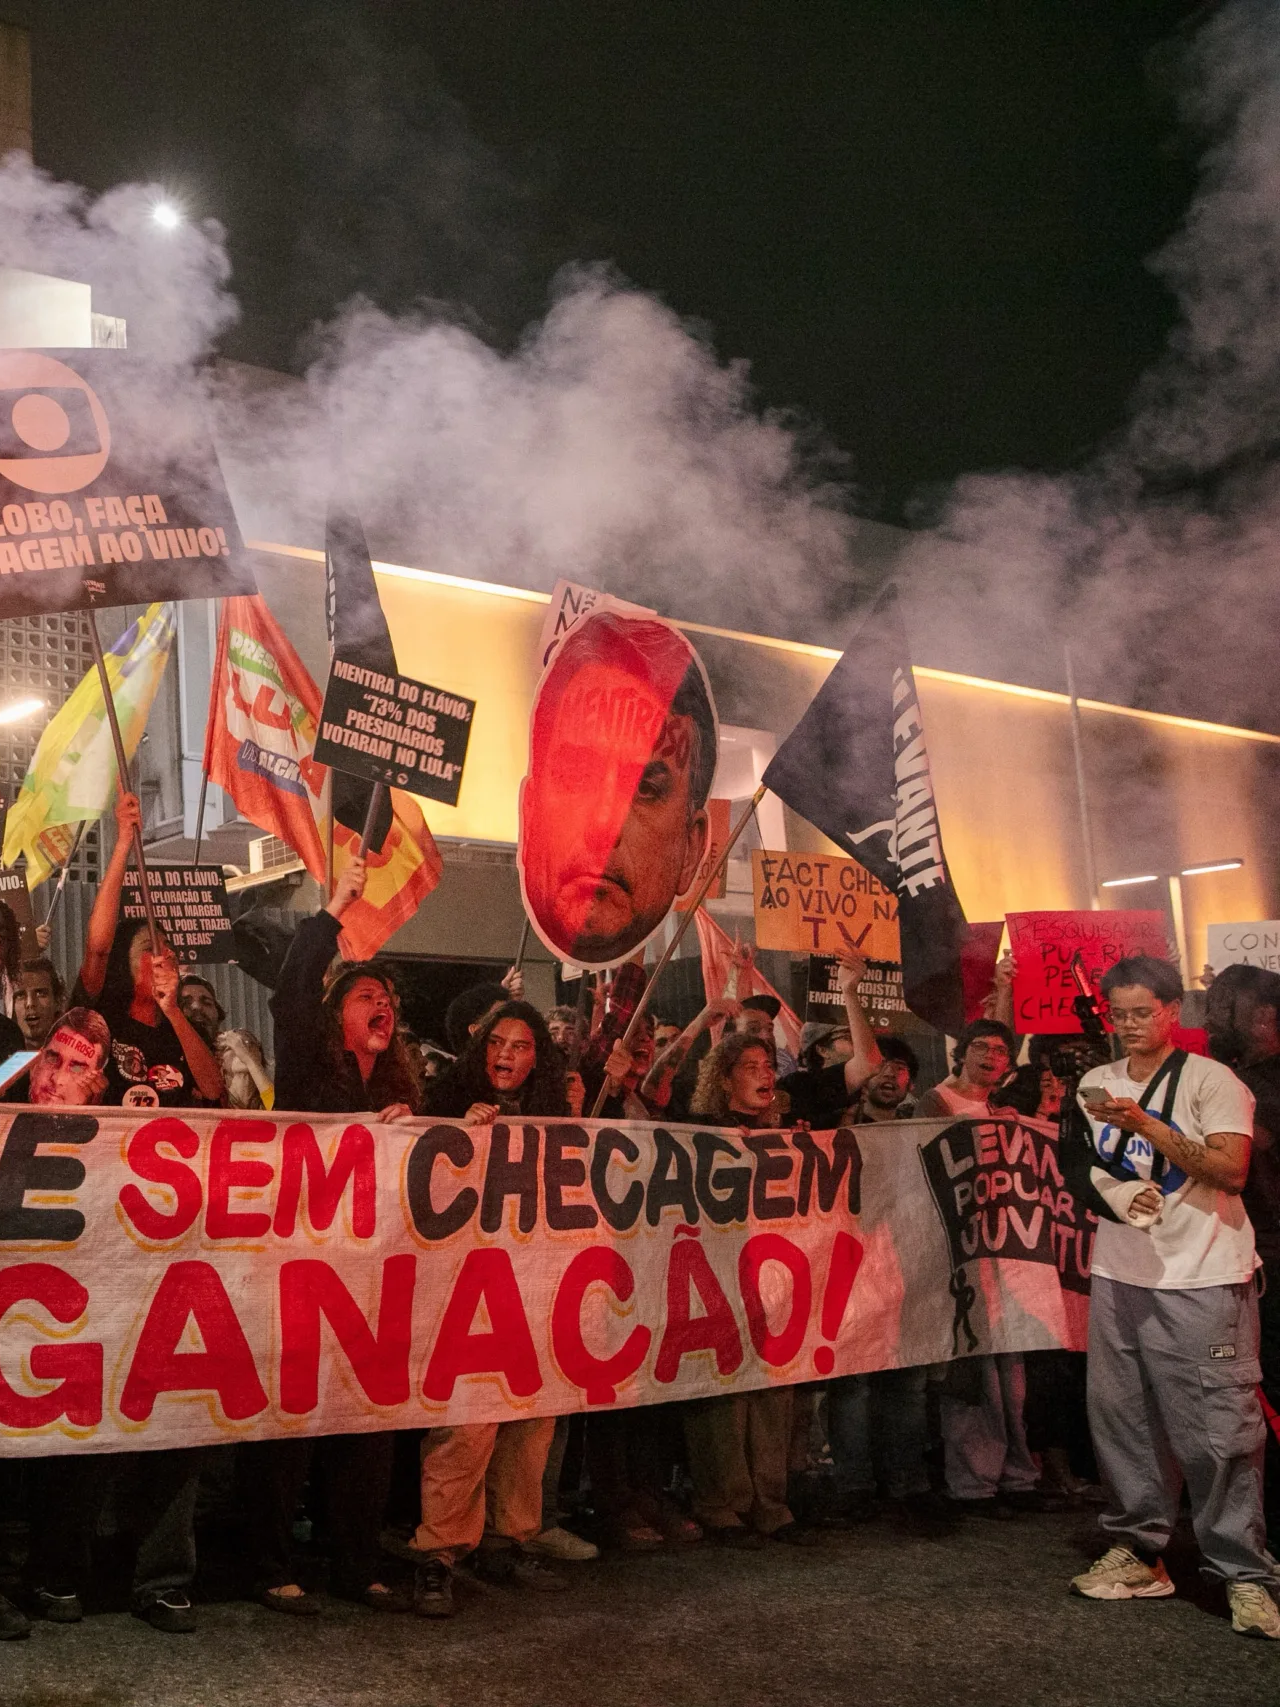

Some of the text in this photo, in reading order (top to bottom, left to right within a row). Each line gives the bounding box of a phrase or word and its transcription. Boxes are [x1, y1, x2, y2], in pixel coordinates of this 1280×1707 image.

[85, 494, 168, 533] FAÇA
[97, 530, 143, 563] AO
[143, 526, 231, 560] VIVO!
[333, 660, 471, 722] MENTIRA DO FLÁVIO:
[345, 709, 445, 757] PRESIDIÁRIOS
[406, 708, 437, 733] DOS
[322, 722, 393, 760] VOTARAM
[395, 746, 417, 768] NO
[164, 871, 181, 887] DO
[183, 868, 223, 887] FLÁVIO:
[760, 858, 830, 887] FACT
[124, 904, 223, 918] PETRLEO NA MARGEM
[151, 889, 199, 906] PLORAÇÃO
[201, 891, 214, 903] DE
[760, 886, 790, 910] AO
[798, 889, 857, 918] VIVO
[173, 933, 185, 946] DE
[175, 918, 198, 931] PODE
[200, 918, 232, 931] TRAZER
[802, 916, 873, 949] TV
[828, 978, 898, 998] RERDISTA
[118, 1116, 376, 1240] SEM
[408, 1123, 864, 1241] CHECAGEM
[954, 1170, 1076, 1223] POPUAR
